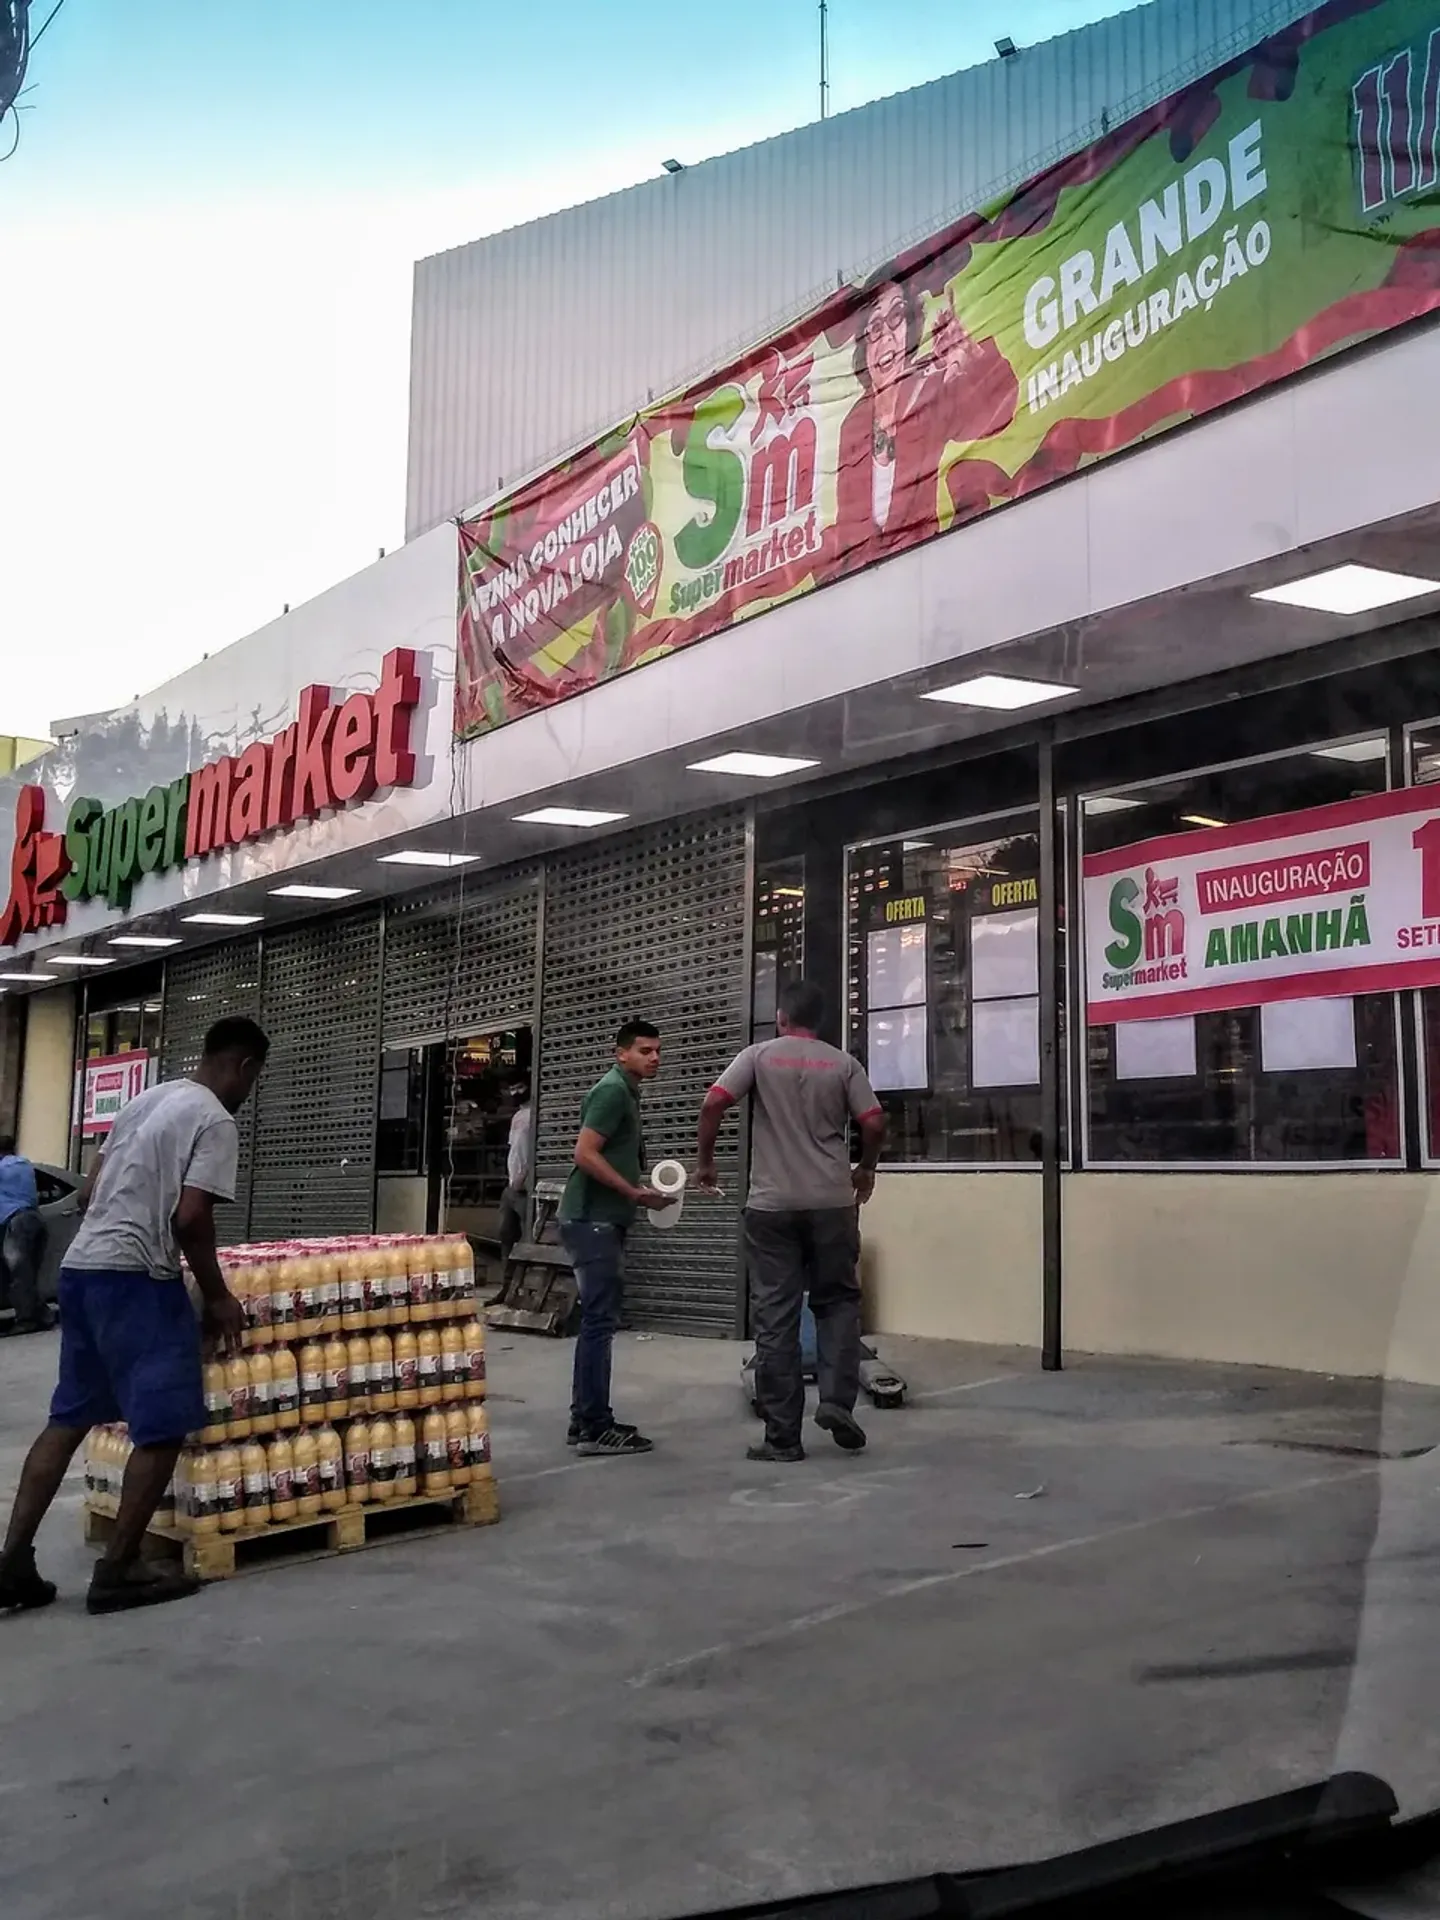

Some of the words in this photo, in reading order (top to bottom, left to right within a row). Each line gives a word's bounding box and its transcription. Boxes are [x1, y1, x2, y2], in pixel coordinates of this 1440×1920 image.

[1023, 119, 1268, 349] GRANDE
[1027, 220, 1272, 414] INAUGURAÇÃO
[529, 464, 640, 573] CONHECER
[627, 534, 656, 589] 100
[668, 510, 817, 614] Supermarket
[491, 612, 506, 650] A
[509, 567, 569, 638] NOVA
[567, 523, 623, 594] LOJA
[64, 646, 420, 912] Supermarket
[886, 896, 926, 922] OFERTA
[991, 878, 1038, 907] OFERTA
[1205, 850, 1364, 904] INAUGURAÇÃO
[1102, 957, 1188, 992] Supermarket
[1204, 894, 1371, 968] AMANHÃ
